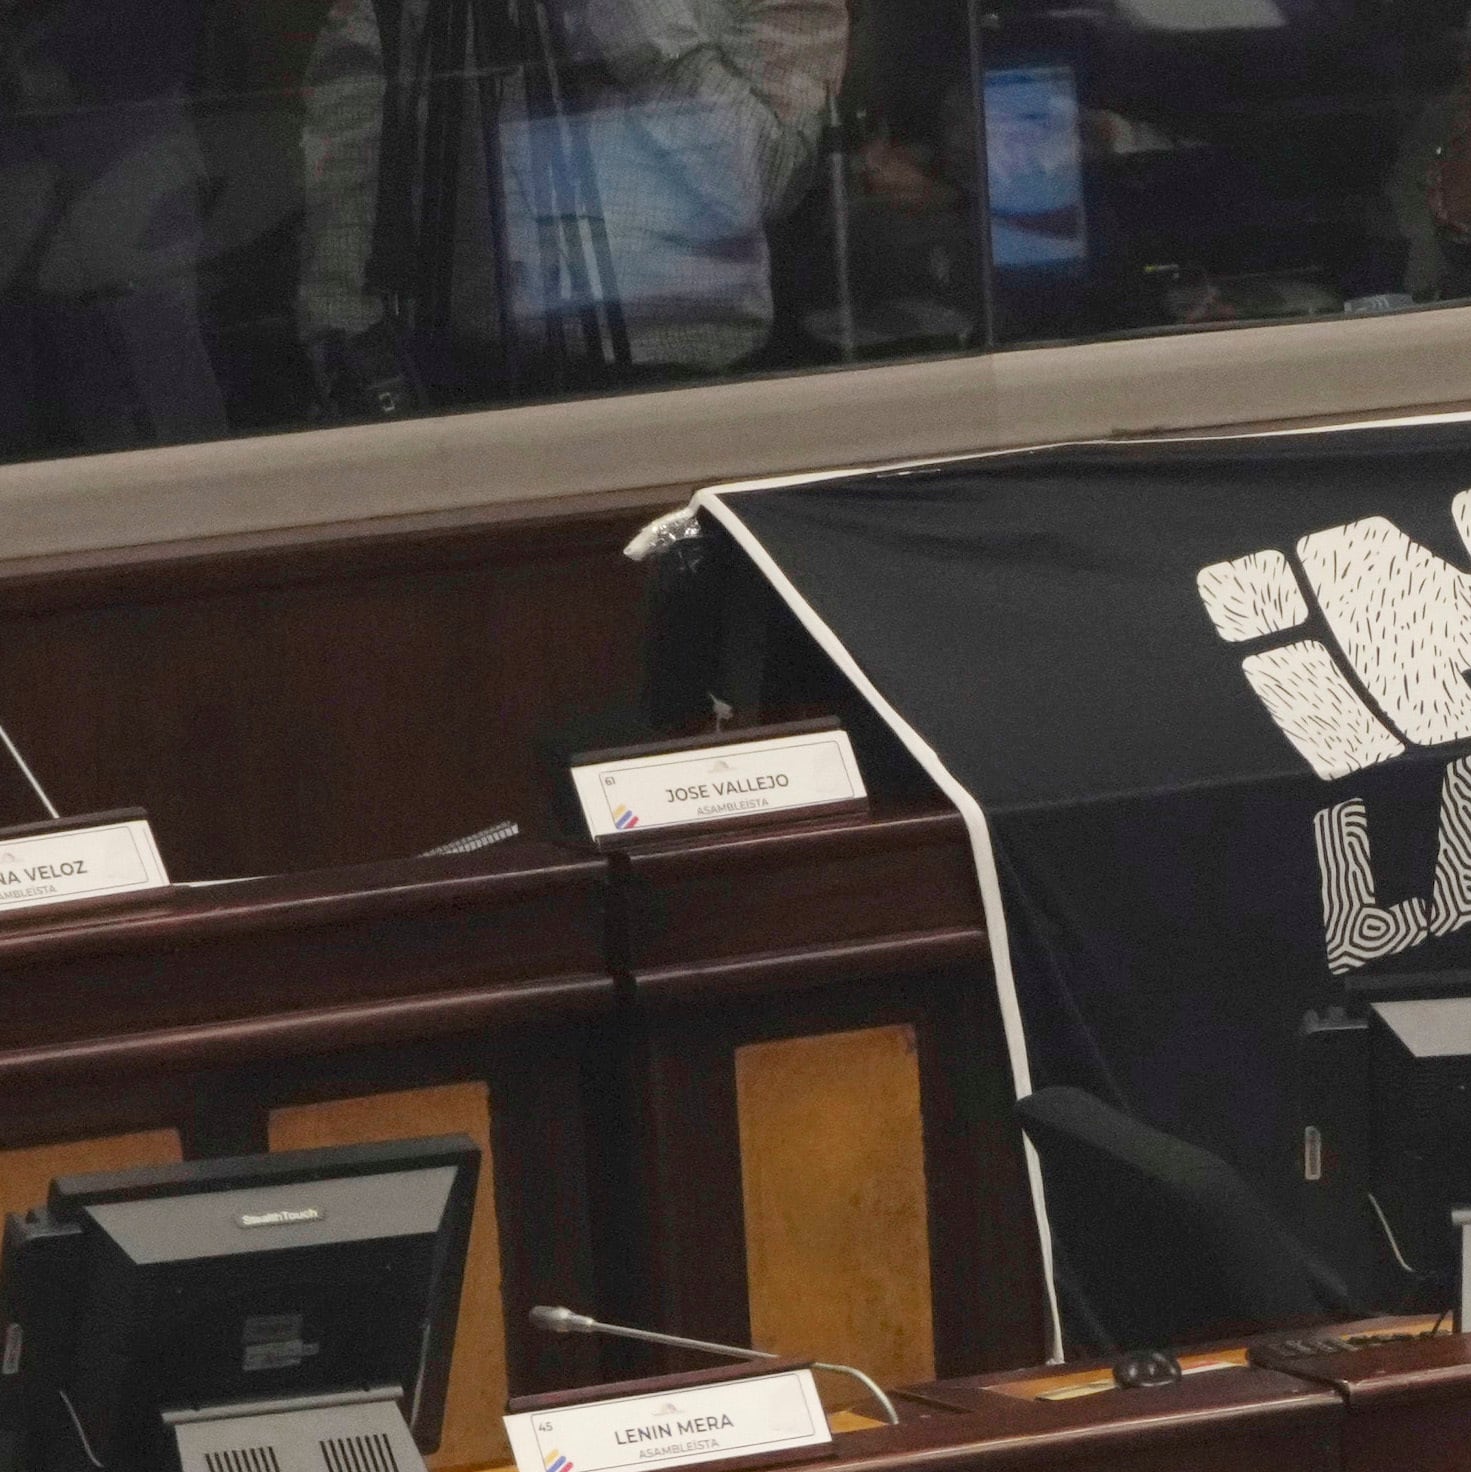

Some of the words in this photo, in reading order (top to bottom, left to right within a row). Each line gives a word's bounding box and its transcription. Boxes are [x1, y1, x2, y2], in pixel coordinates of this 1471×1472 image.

[665, 785, 707, 803] JOSE
[712, 773, 789, 798] VALLEJO
[24, 860, 88, 881] VELOZ
[241, 1208, 318, 1225] StealthTouch
[538, 1421, 553, 1432] 45
[614, 1424, 673, 1445] LENIN
[677, 1413, 734, 1436] MERA
